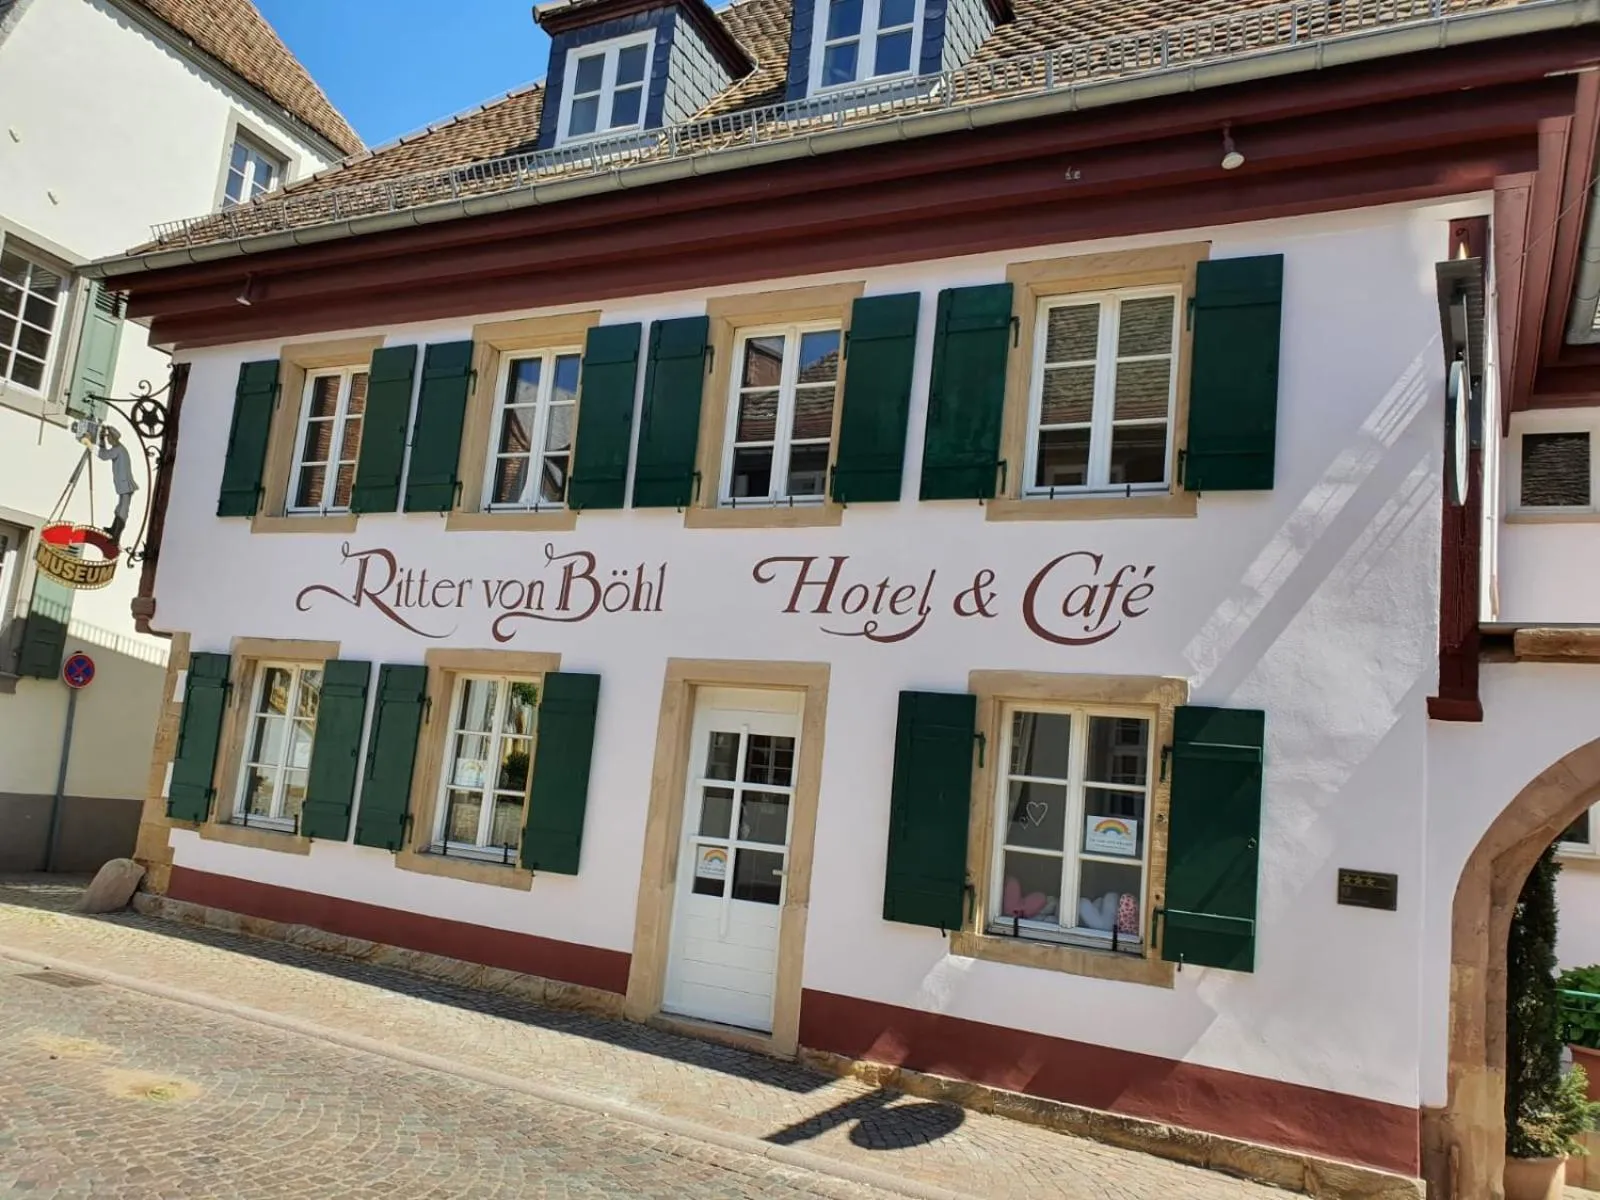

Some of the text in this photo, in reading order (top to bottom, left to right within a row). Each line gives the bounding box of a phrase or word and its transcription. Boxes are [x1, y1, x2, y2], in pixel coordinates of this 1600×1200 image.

[37, 548, 114, 582] MUSEUM
[296, 541, 1156, 647] Ritter von Böhl Hotel & Café
